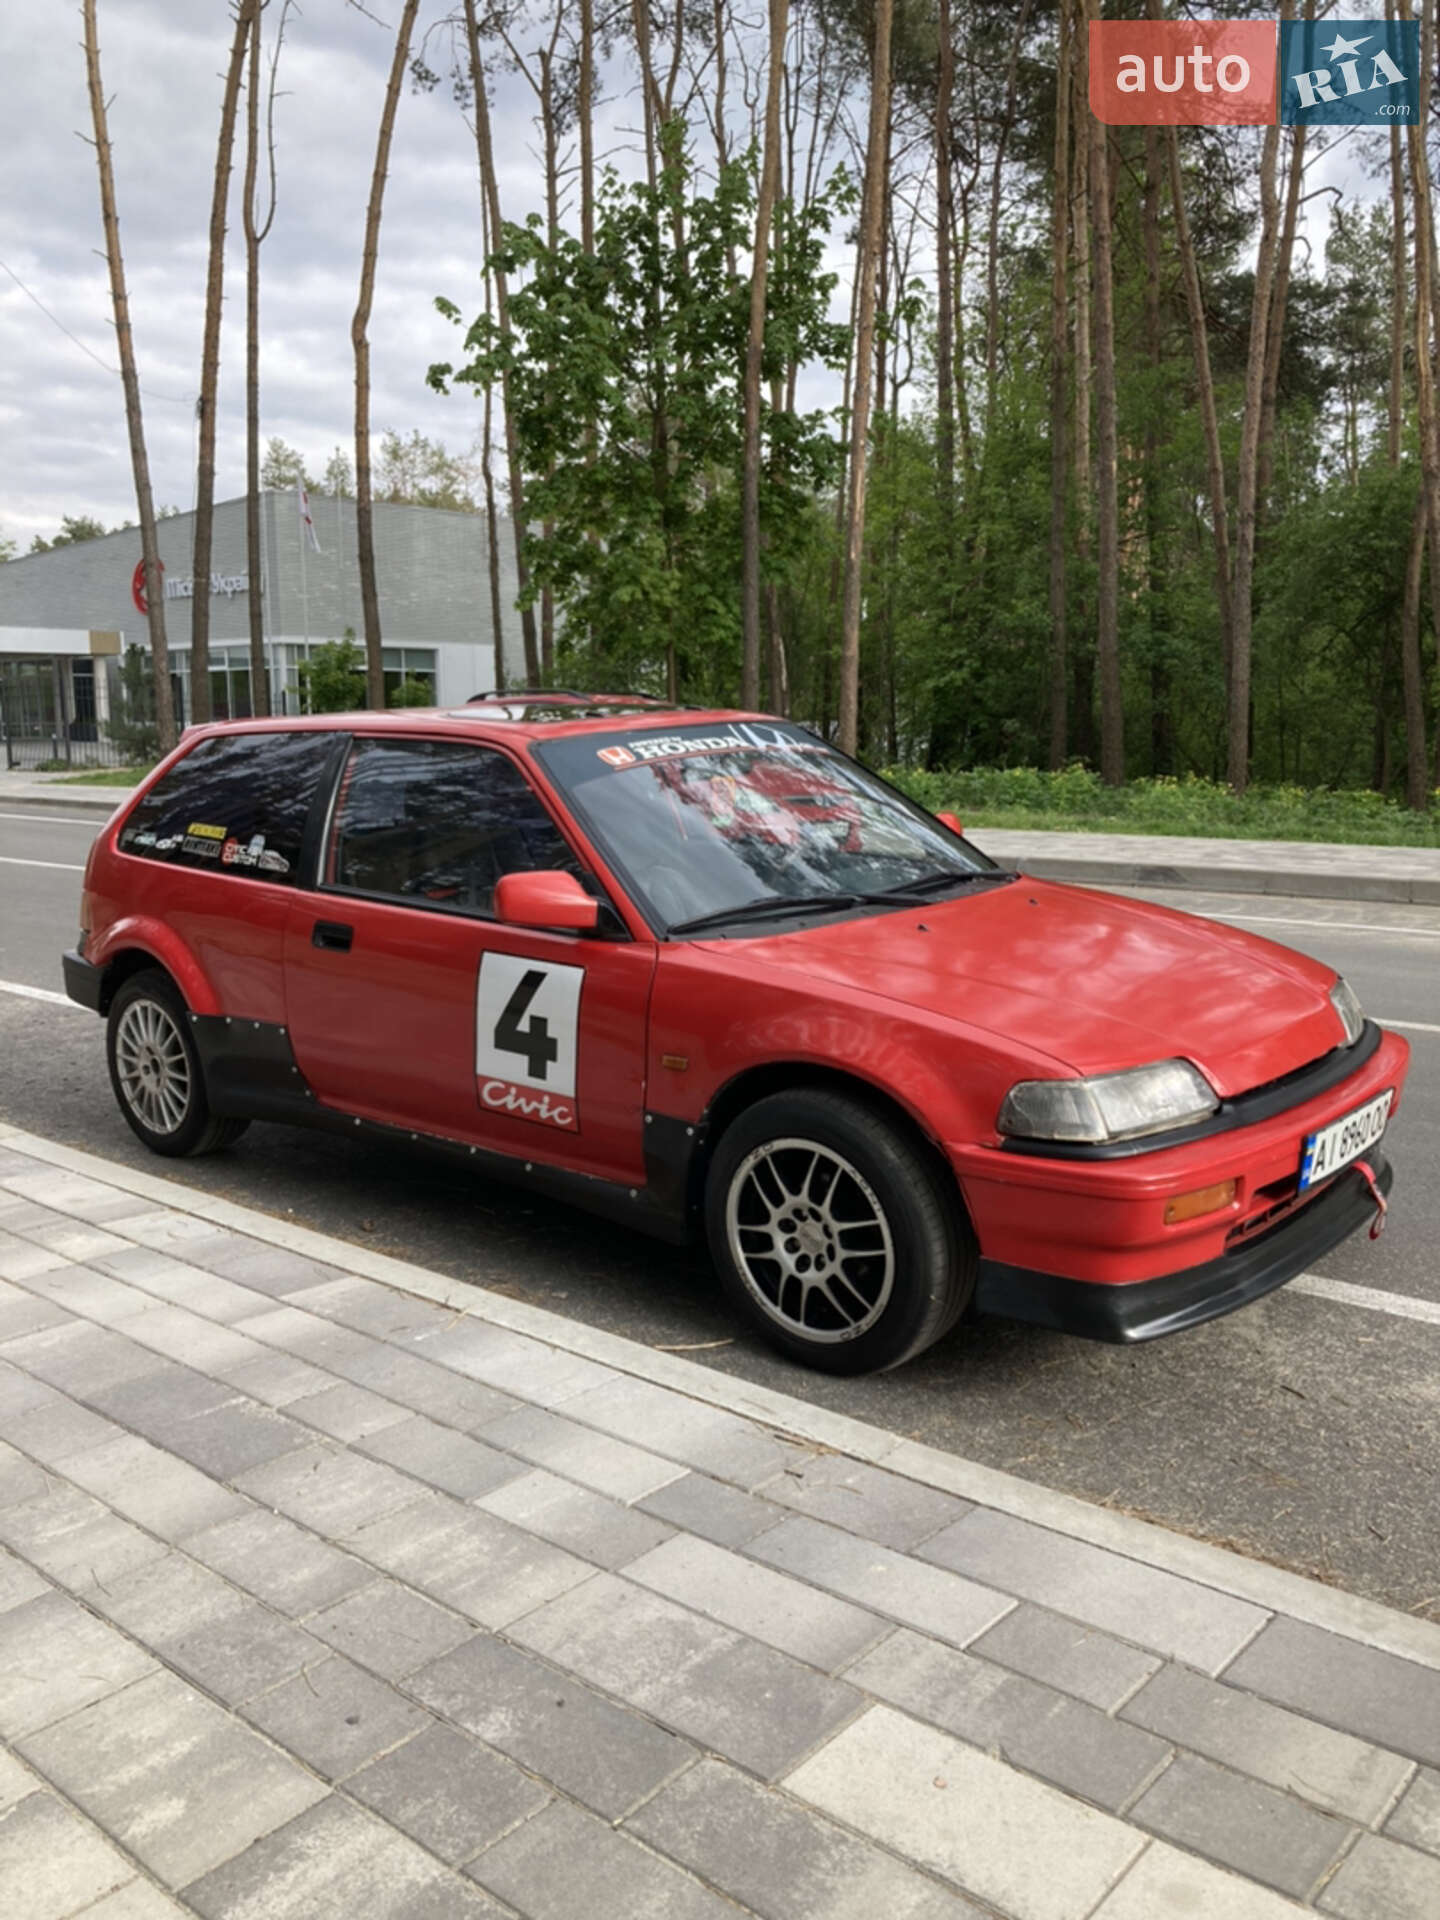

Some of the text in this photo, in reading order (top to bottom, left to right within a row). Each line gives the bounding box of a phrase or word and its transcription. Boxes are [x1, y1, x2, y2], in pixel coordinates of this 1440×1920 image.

[634, 736, 752, 759] HONDA
[494, 970, 558, 1081] 4
[482, 1080, 573, 1125] Civic
[1312, 1132, 1337, 1175] AI
